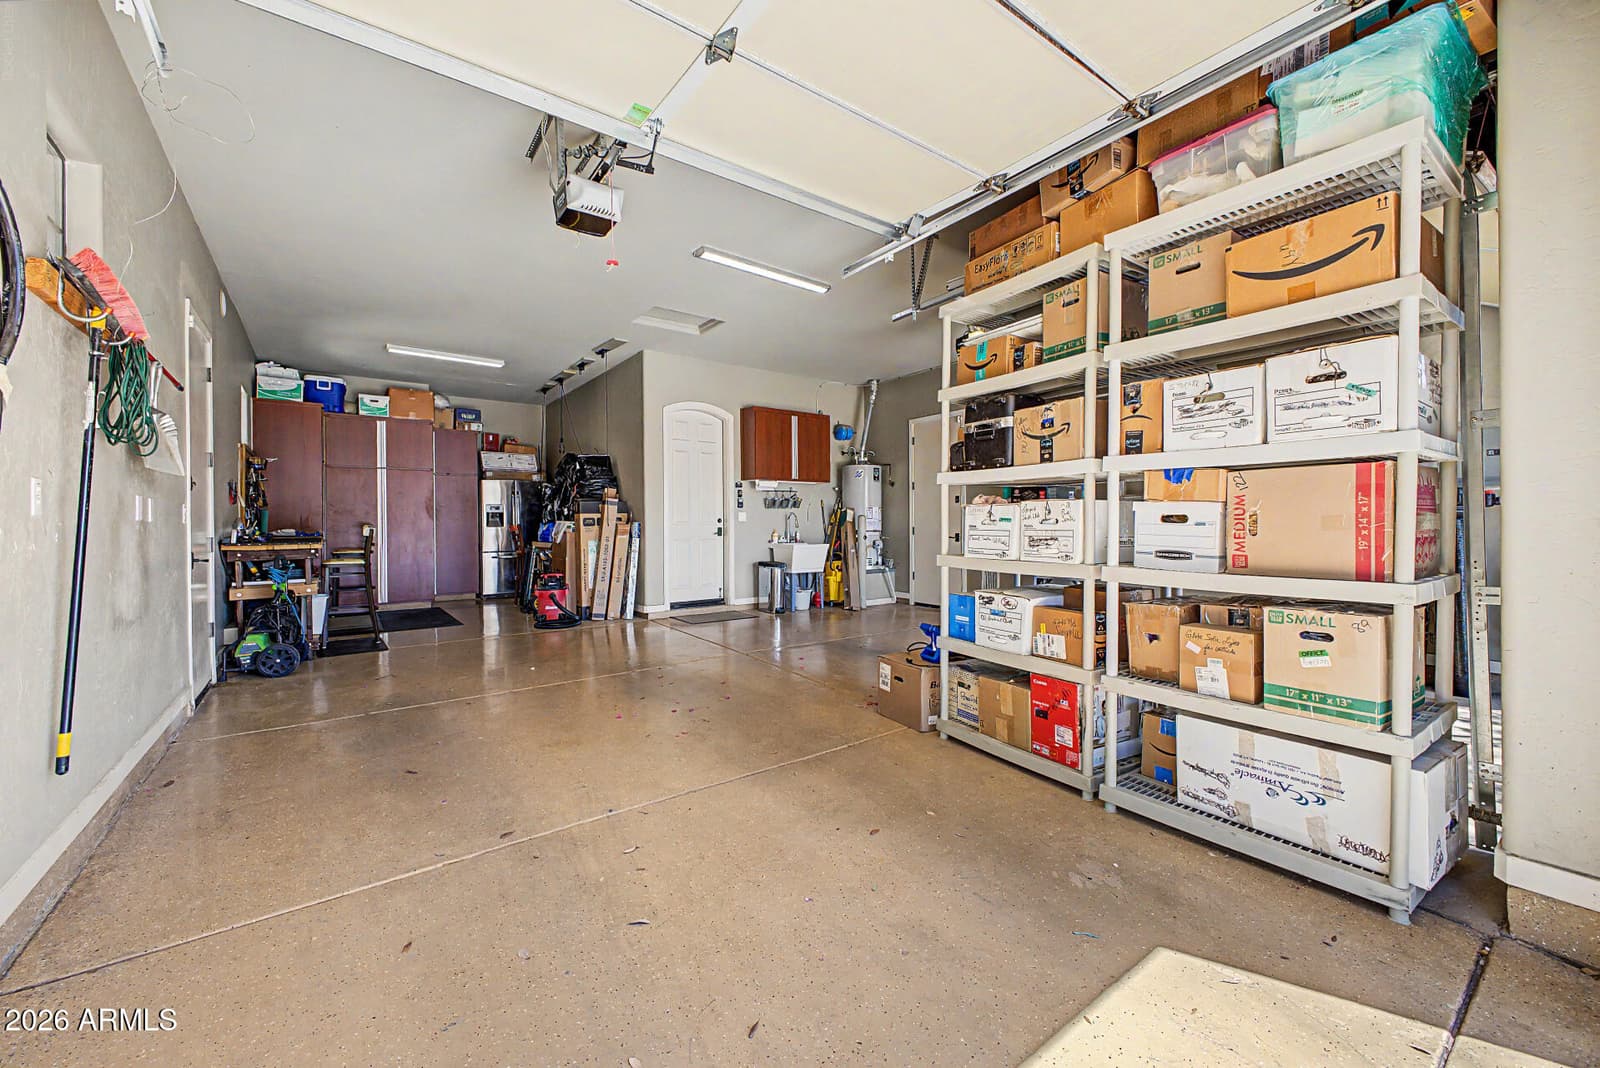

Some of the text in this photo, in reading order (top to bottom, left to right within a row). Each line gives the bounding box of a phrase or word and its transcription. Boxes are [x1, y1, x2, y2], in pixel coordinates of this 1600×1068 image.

[1233, 494, 1246, 553] MEDIUM
[1358, 537, 1369, 550] 19"
[1286, 613, 1337, 628] SMALL
[1285, 688, 1300, 698] 17"
[1311, 693, 1325, 702] 11"
[1335, 697, 1352, 707] 13"
